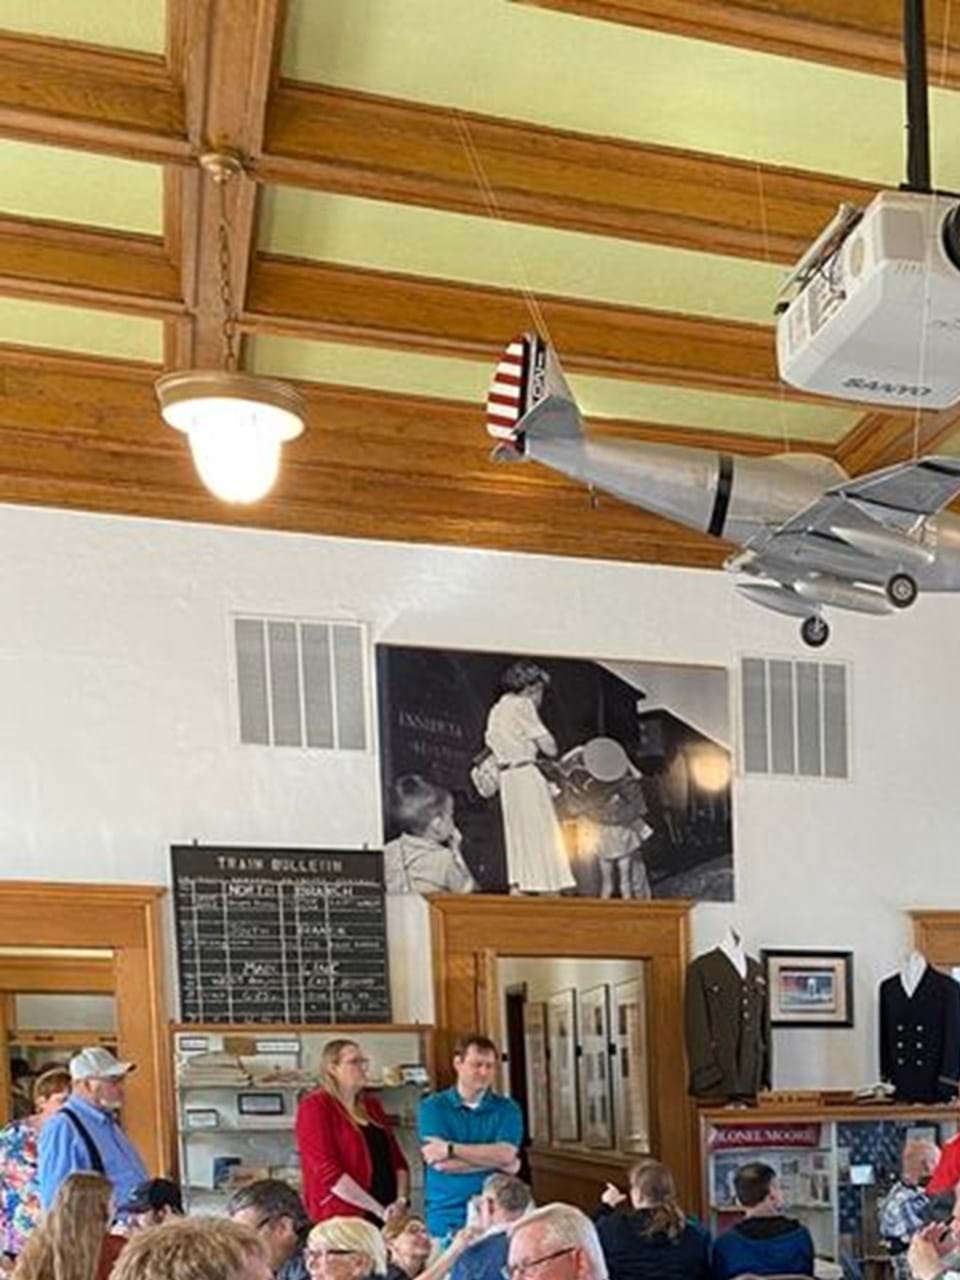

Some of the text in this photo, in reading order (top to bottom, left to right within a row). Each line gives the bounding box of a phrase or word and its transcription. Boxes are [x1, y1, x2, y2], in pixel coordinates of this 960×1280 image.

[842, 377, 932, 396] SANYO
[216, 856, 343, 873] TRAIN BULLETIN
[707, 1128, 763, 1144] OLONEL
